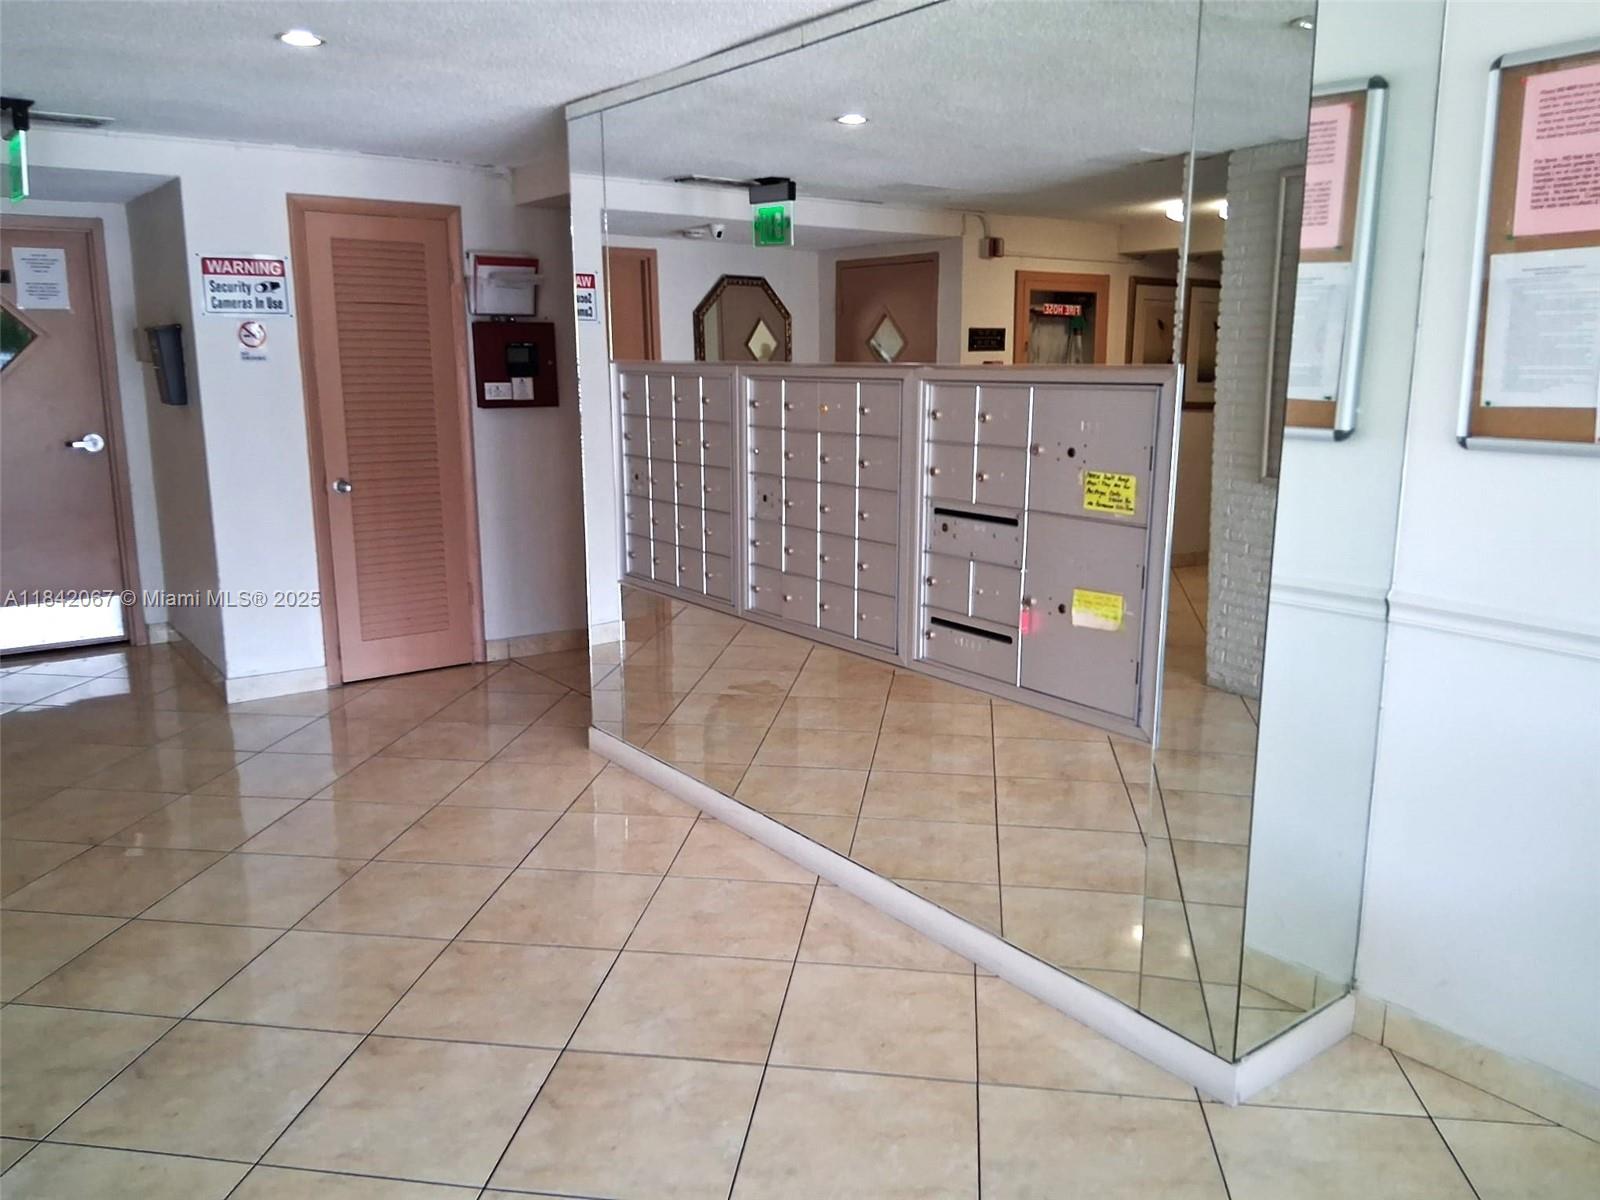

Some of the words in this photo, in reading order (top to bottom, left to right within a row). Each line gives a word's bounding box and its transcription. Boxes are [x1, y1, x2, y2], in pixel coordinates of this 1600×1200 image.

[205, 259, 283, 275] WARNING
[209, 279, 252, 296] Security
[211, 296, 253, 309] Cameras
[255, 297, 265, 309] In
[266, 297, 283, 310] Use
